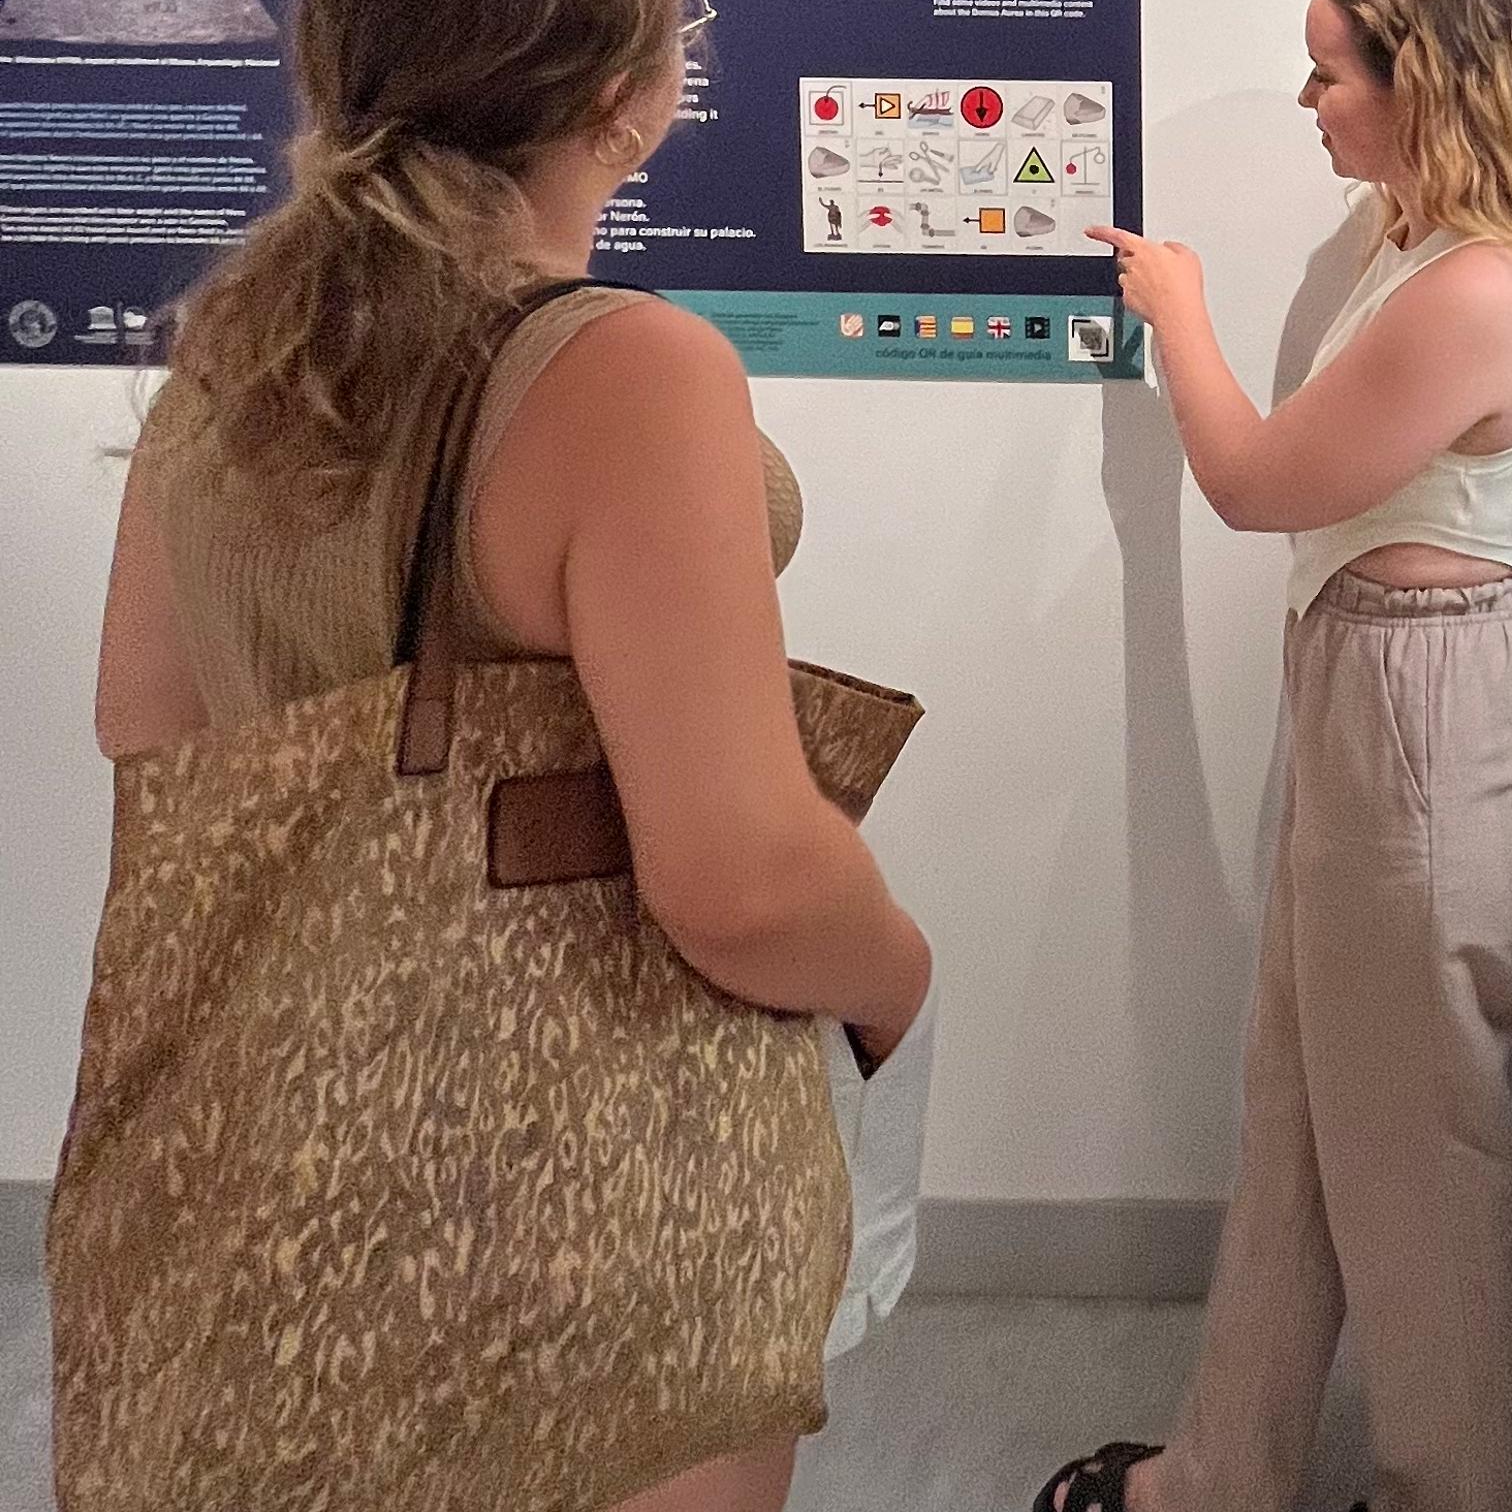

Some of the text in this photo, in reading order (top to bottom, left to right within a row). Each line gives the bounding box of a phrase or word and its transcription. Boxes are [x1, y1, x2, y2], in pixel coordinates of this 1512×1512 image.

[610, 210, 650, 222] Nerón.
[610, 228, 636, 237] para
[639, 226, 691, 236] construir
[694, 229, 707, 237] su
[711, 226, 756, 239] palacio.
[596, 240, 647, 252] de agua.
